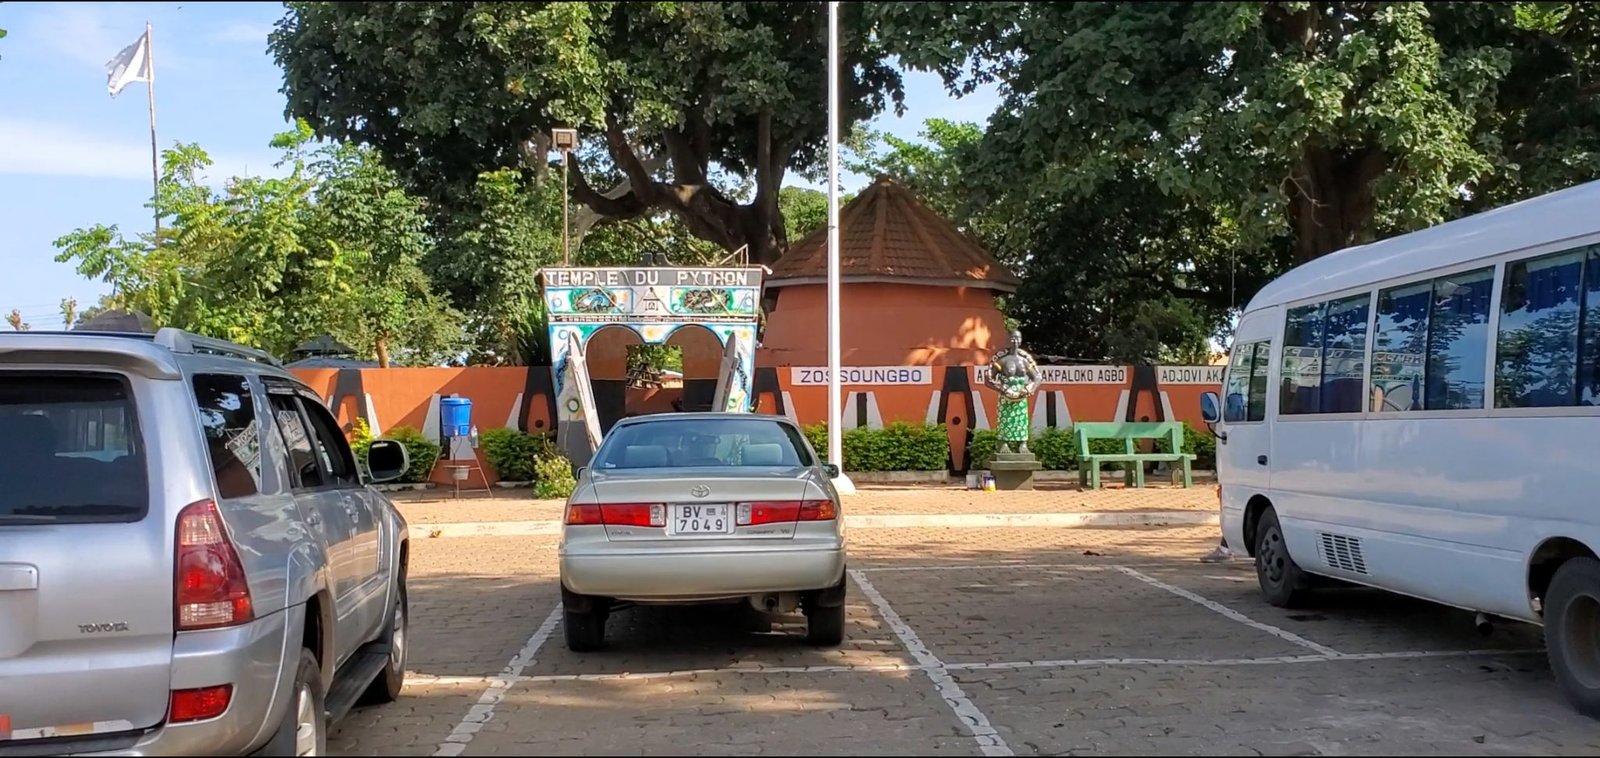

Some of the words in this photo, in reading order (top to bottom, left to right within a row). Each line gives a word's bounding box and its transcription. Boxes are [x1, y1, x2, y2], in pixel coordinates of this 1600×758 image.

[546, 270, 618, 287] TEMPLE
[635, 270, 659, 286] DU
[677, 270, 748, 286] PYTHON
[800, 369, 922, 383] ZOSOUNGBO
[1041, 369, 1094, 382] AKPALOKO
[1098, 369, 1125, 382] AGBO
[1161, 369, 1201, 383] ADJOVI
[1206, 369, 1223, 383] AK
[683, 506, 700, 518] BV
[680, 519, 723, 531] 7049
[77, 621, 130, 634] TOYOTA
